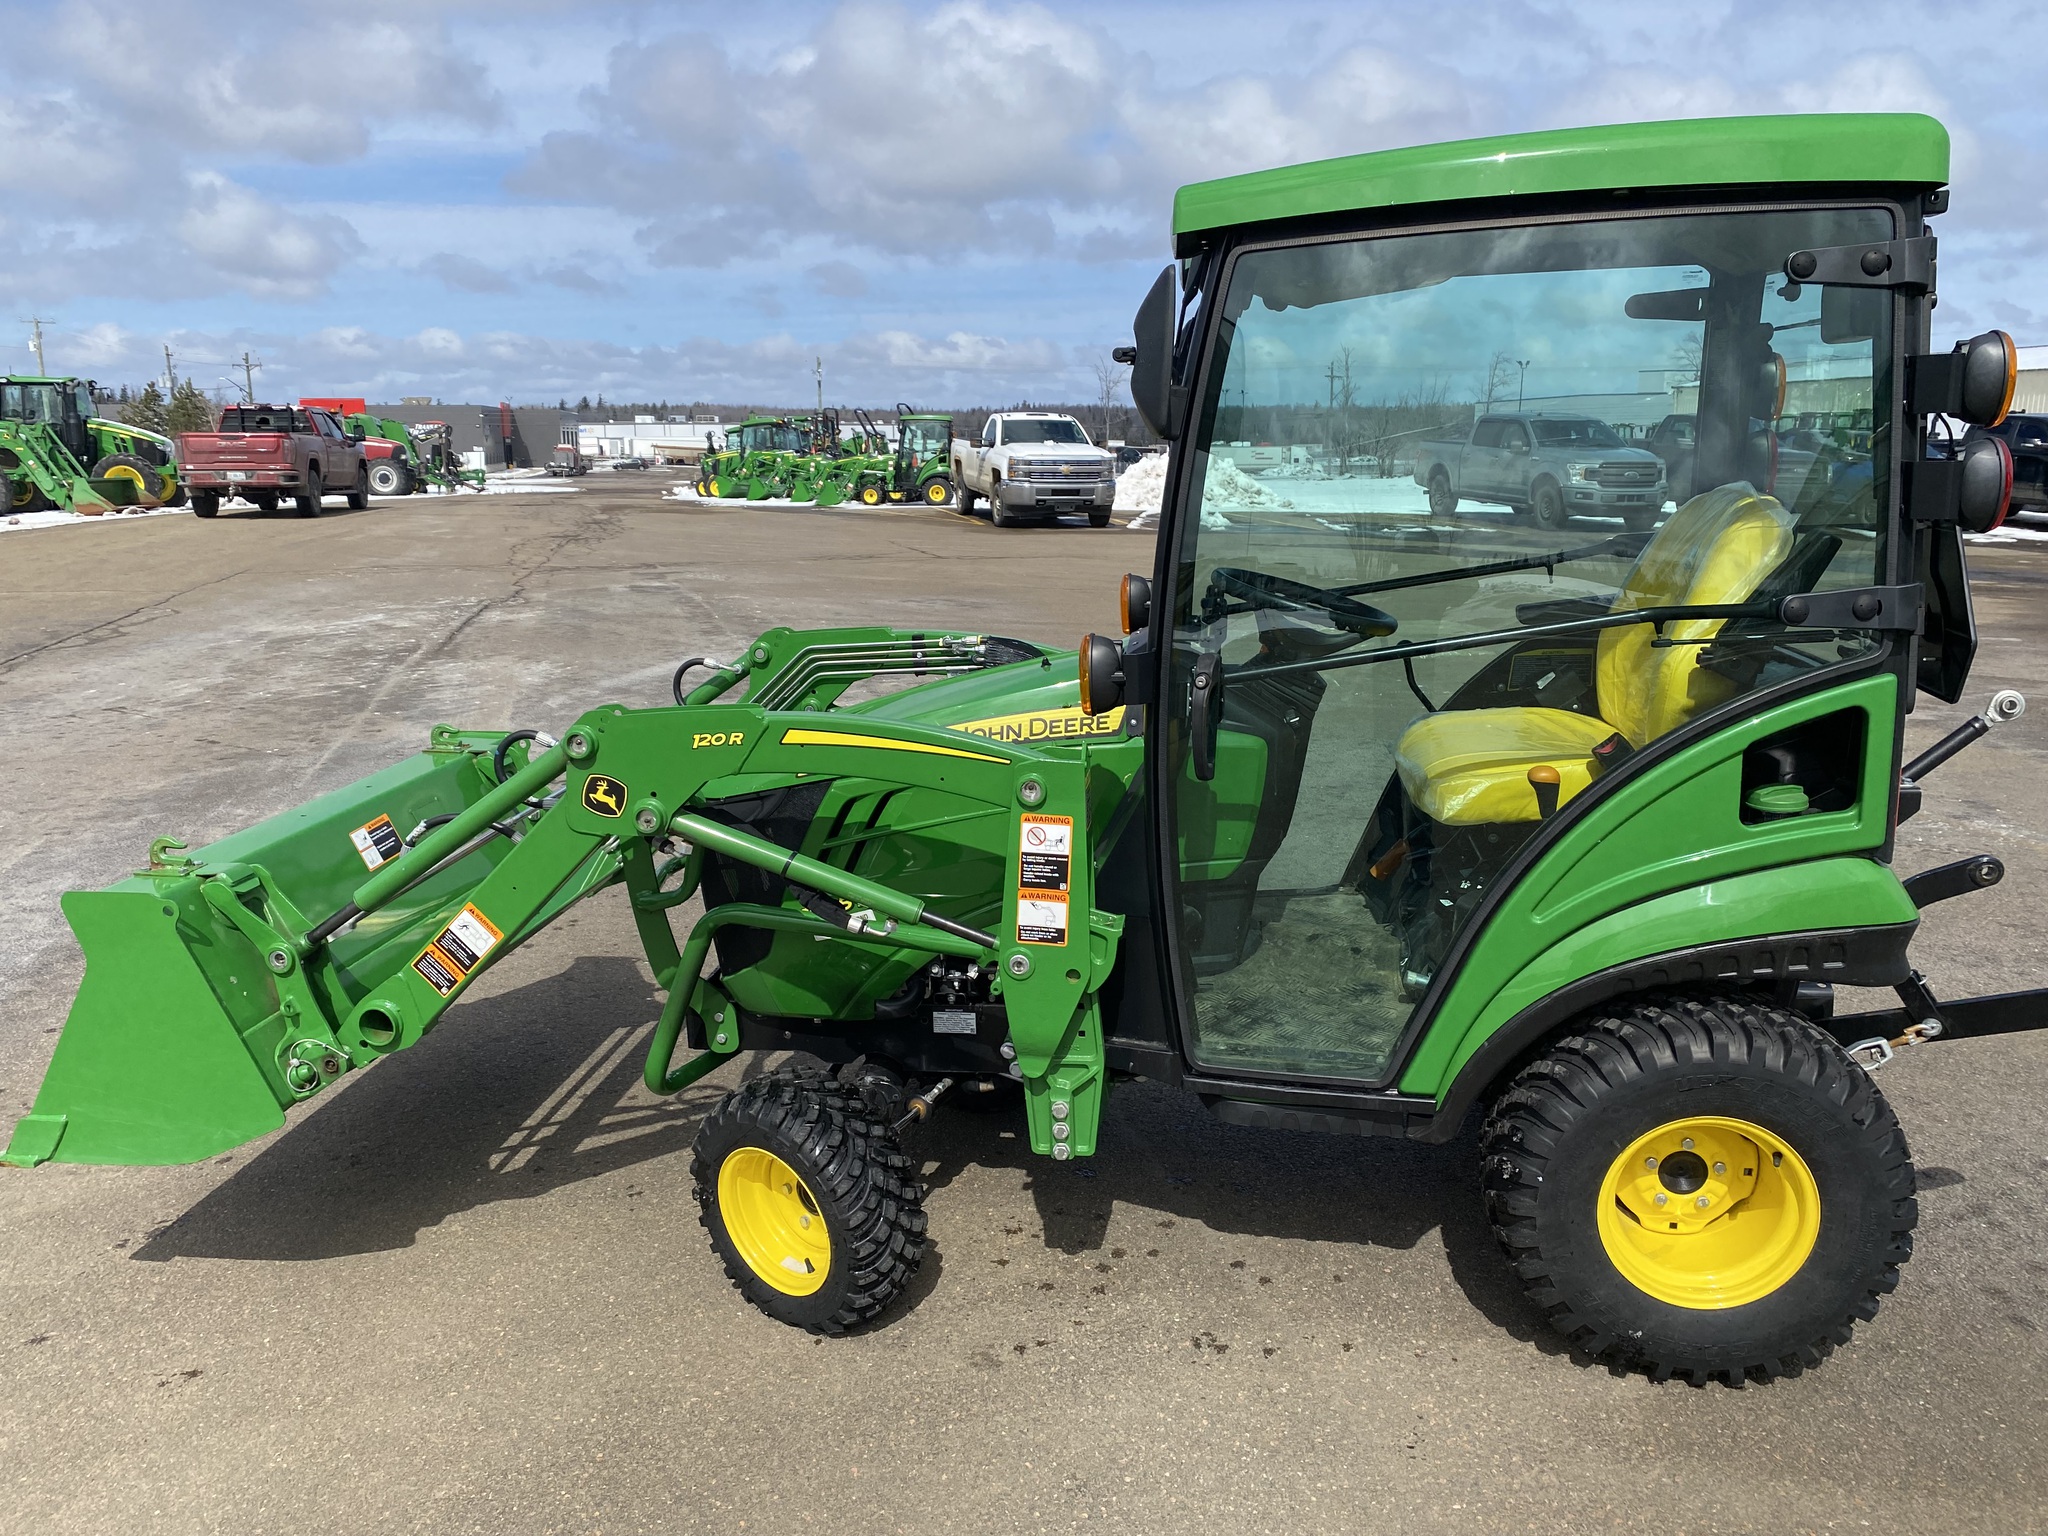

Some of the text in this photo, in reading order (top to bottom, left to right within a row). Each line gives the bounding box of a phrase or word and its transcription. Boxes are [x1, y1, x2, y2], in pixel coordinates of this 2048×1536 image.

[1029, 714, 1111, 738] DEERE
[1031, 815, 1070, 825] WARNING
[1028, 892, 1066, 902] WARNING
[474, 913, 499, 936] WARNING
[436, 955, 460, 978] WARNING
